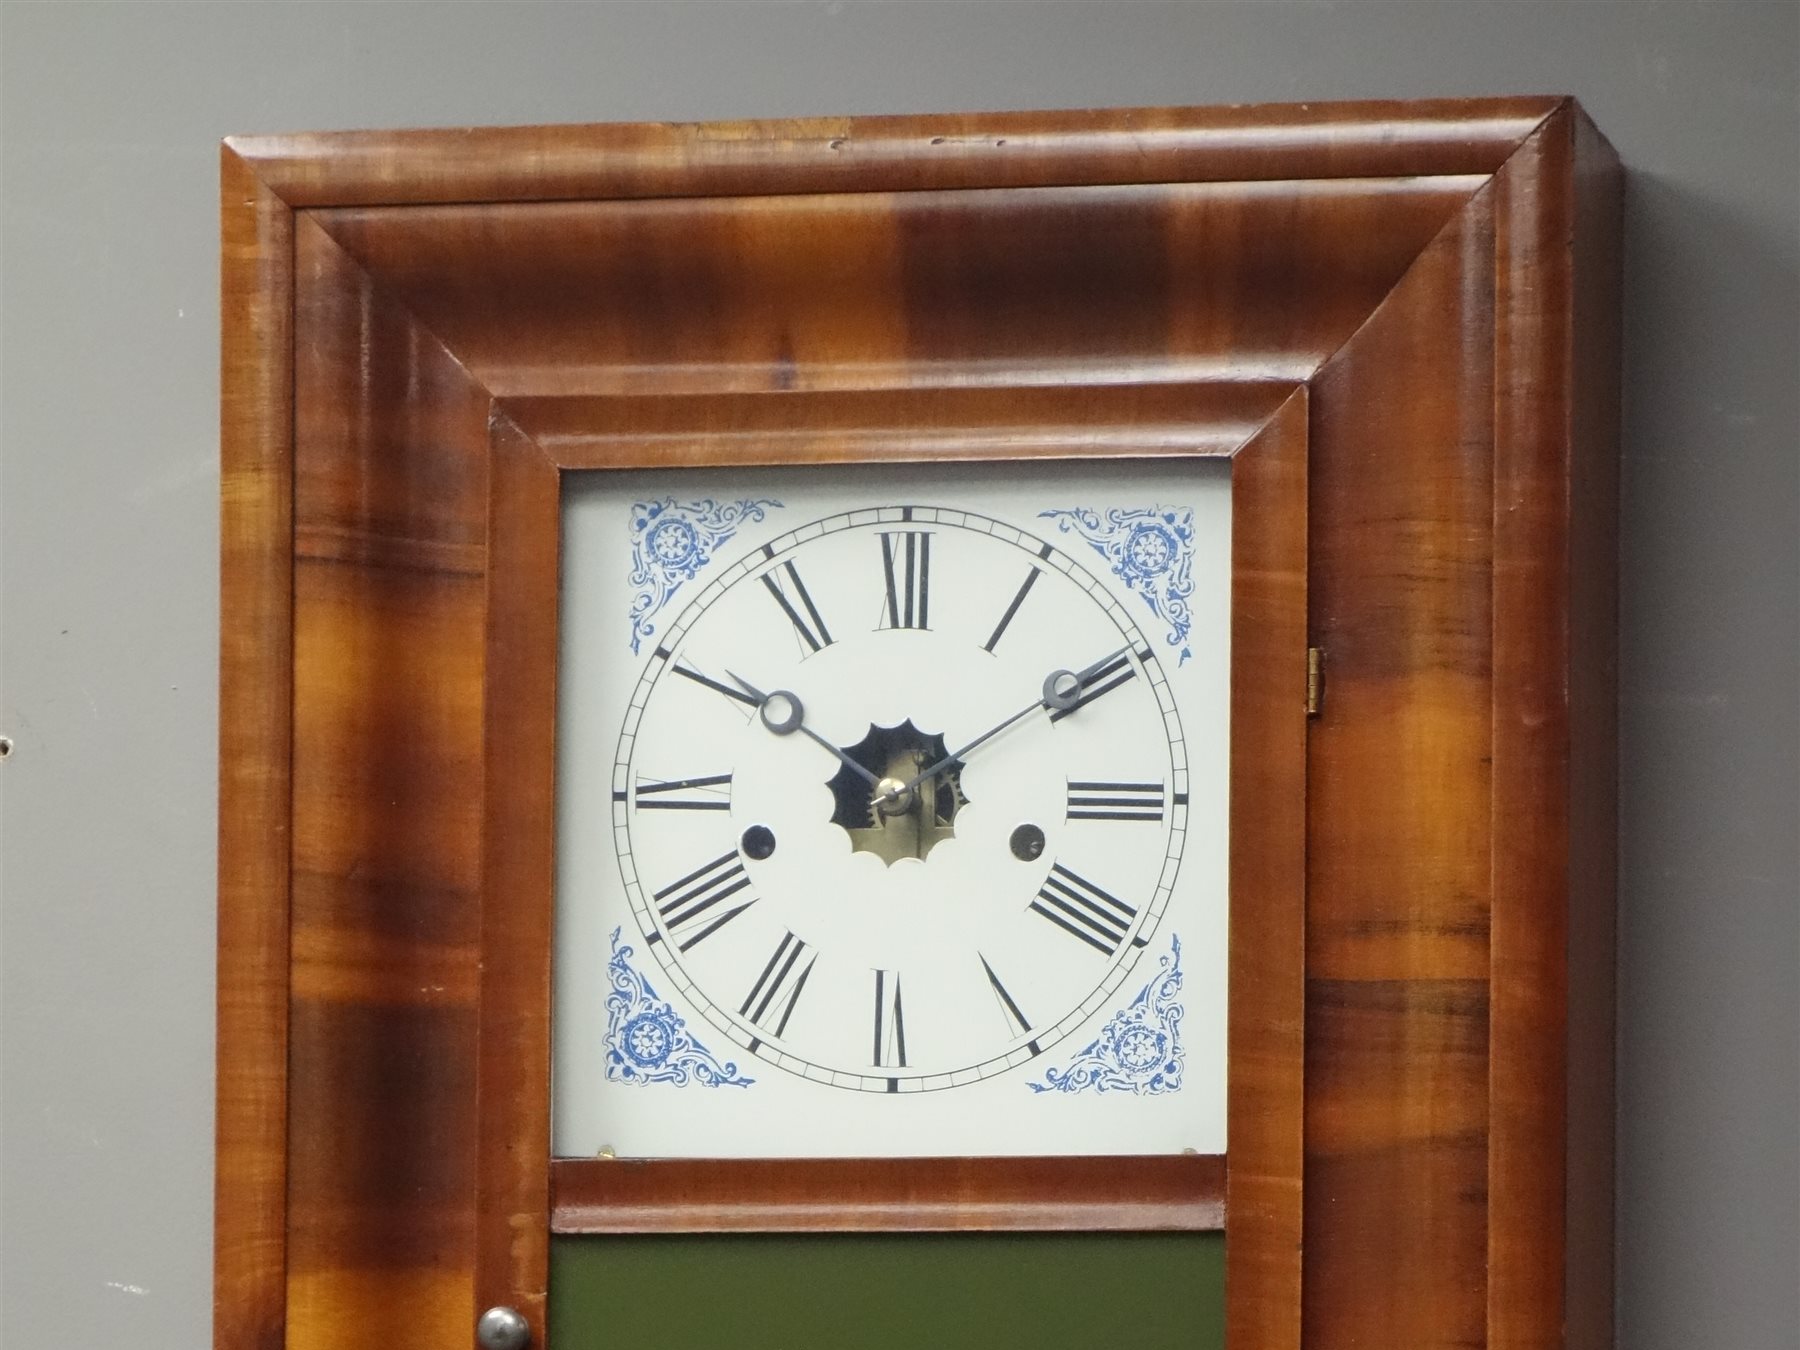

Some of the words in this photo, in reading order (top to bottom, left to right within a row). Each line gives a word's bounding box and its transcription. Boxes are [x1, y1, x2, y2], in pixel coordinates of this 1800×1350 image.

[755, 557, 839, 660] XI
[873, 531, 936, 631] XII
[979, 562, 1047, 658] I
[634, 768, 734, 816] IX
[1065, 776, 1164, 825] III
[652, 849, 761, 954] VIII
[1026, 857, 1141, 960] IIII
[733, 926, 819, 1040] VII
[870, 968, 913, 1067] VI
[977, 950, 1038, 1042] V
